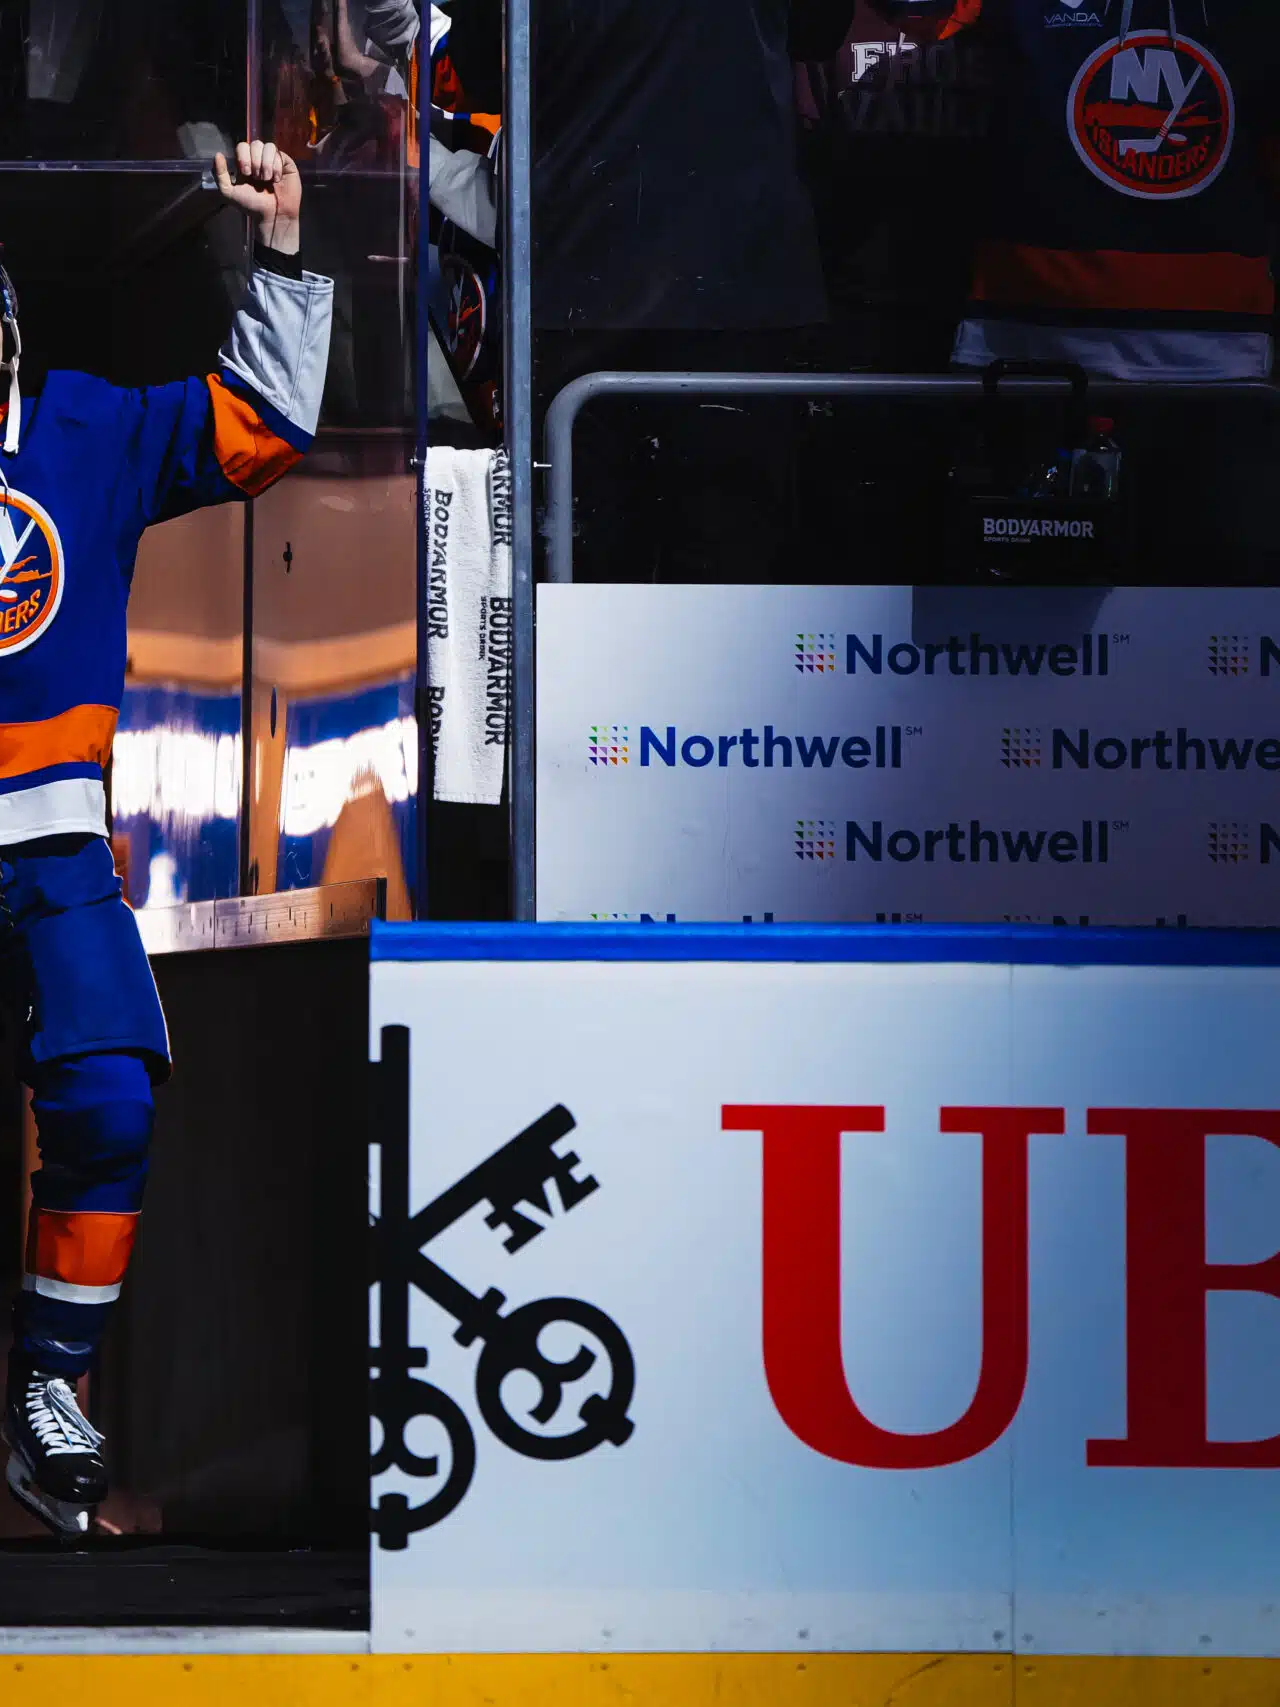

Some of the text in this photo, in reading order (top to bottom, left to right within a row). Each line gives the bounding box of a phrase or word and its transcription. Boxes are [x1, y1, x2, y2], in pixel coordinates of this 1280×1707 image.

[1044, 12, 1100, 24] VANDA
[1110, 47, 1204, 105] NY
[1091, 121, 1211, 180] ISLANDERS
[983, 517, 1096, 539] BODYARMOR
[428, 489, 453, 640] BODYARMOR
[485, 597, 513, 746] BODYARMOR
[845, 633, 1108, 676] Northwell
[640, 725, 902, 768] Northwell
[1053, 728, 1280, 771] Northwe
[845, 820, 1108, 863] Northwell
